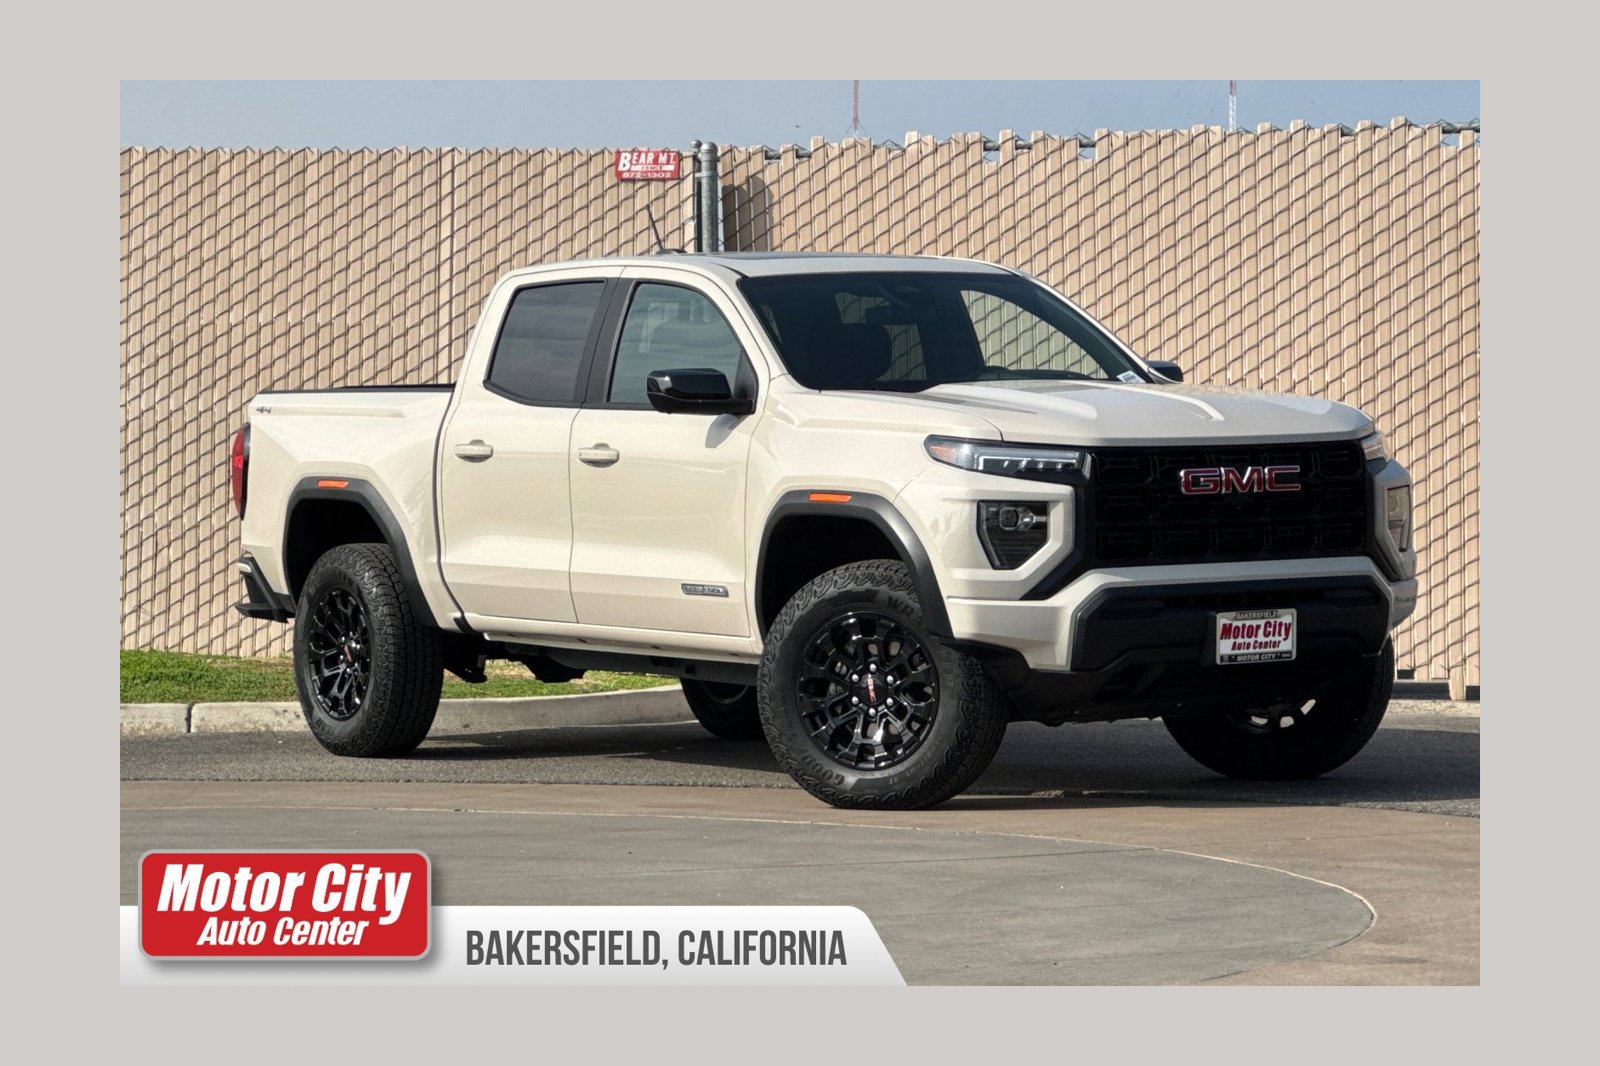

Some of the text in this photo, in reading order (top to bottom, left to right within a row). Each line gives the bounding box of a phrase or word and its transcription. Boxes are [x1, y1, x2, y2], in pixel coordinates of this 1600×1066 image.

[618, 152, 655, 171] BEAR
[1180, 465, 1301, 494] GMC
[1236, 611, 1279, 620] BAKERSFIELD
[1220, 620, 1292, 641] Motor City
[1231, 640, 1281, 651] Auto Center
[1236, 653, 1260, 661] MOTOR
[1260, 652, 1276, 660] CITY
